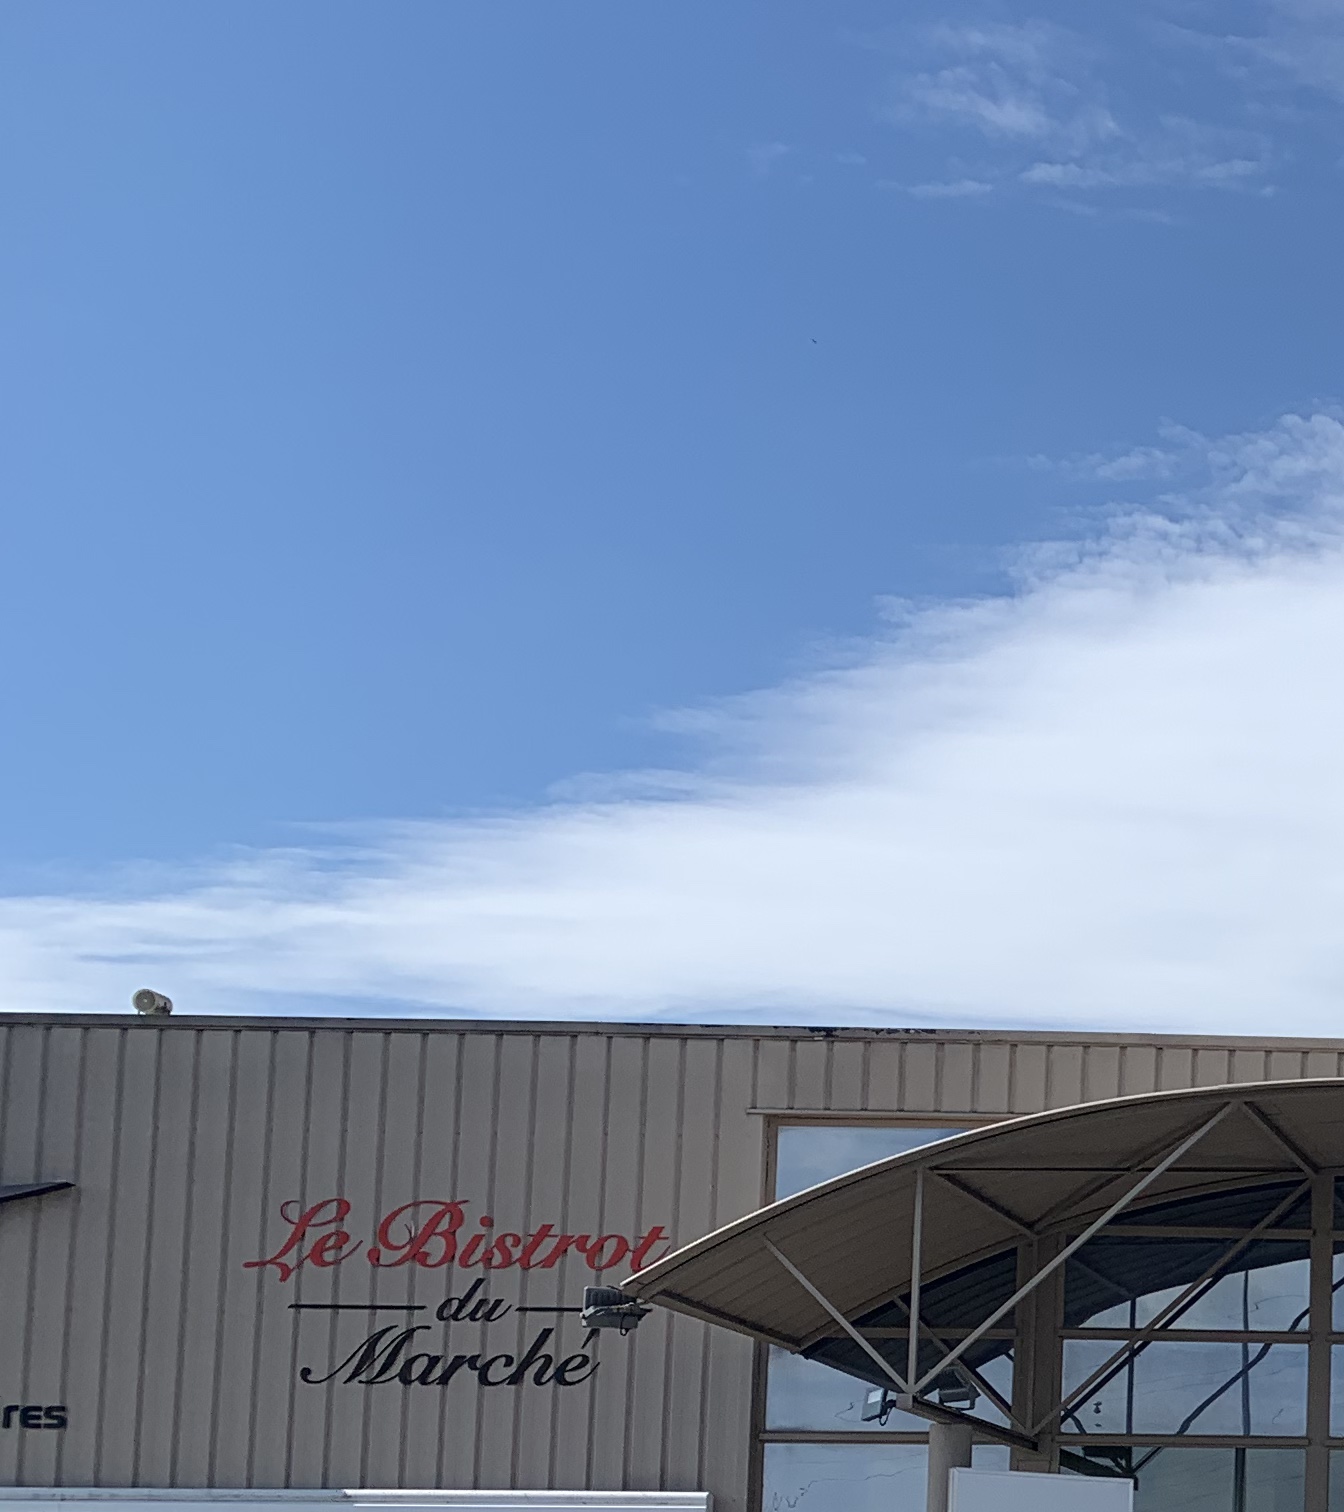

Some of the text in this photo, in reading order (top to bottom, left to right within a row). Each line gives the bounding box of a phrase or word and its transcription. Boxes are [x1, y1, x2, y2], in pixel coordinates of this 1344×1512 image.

[242, 1198, 670, 1283] Le Bistrot
[436, 1278, 512, 1323] du
[300, 1324, 600, 1388] Marché
